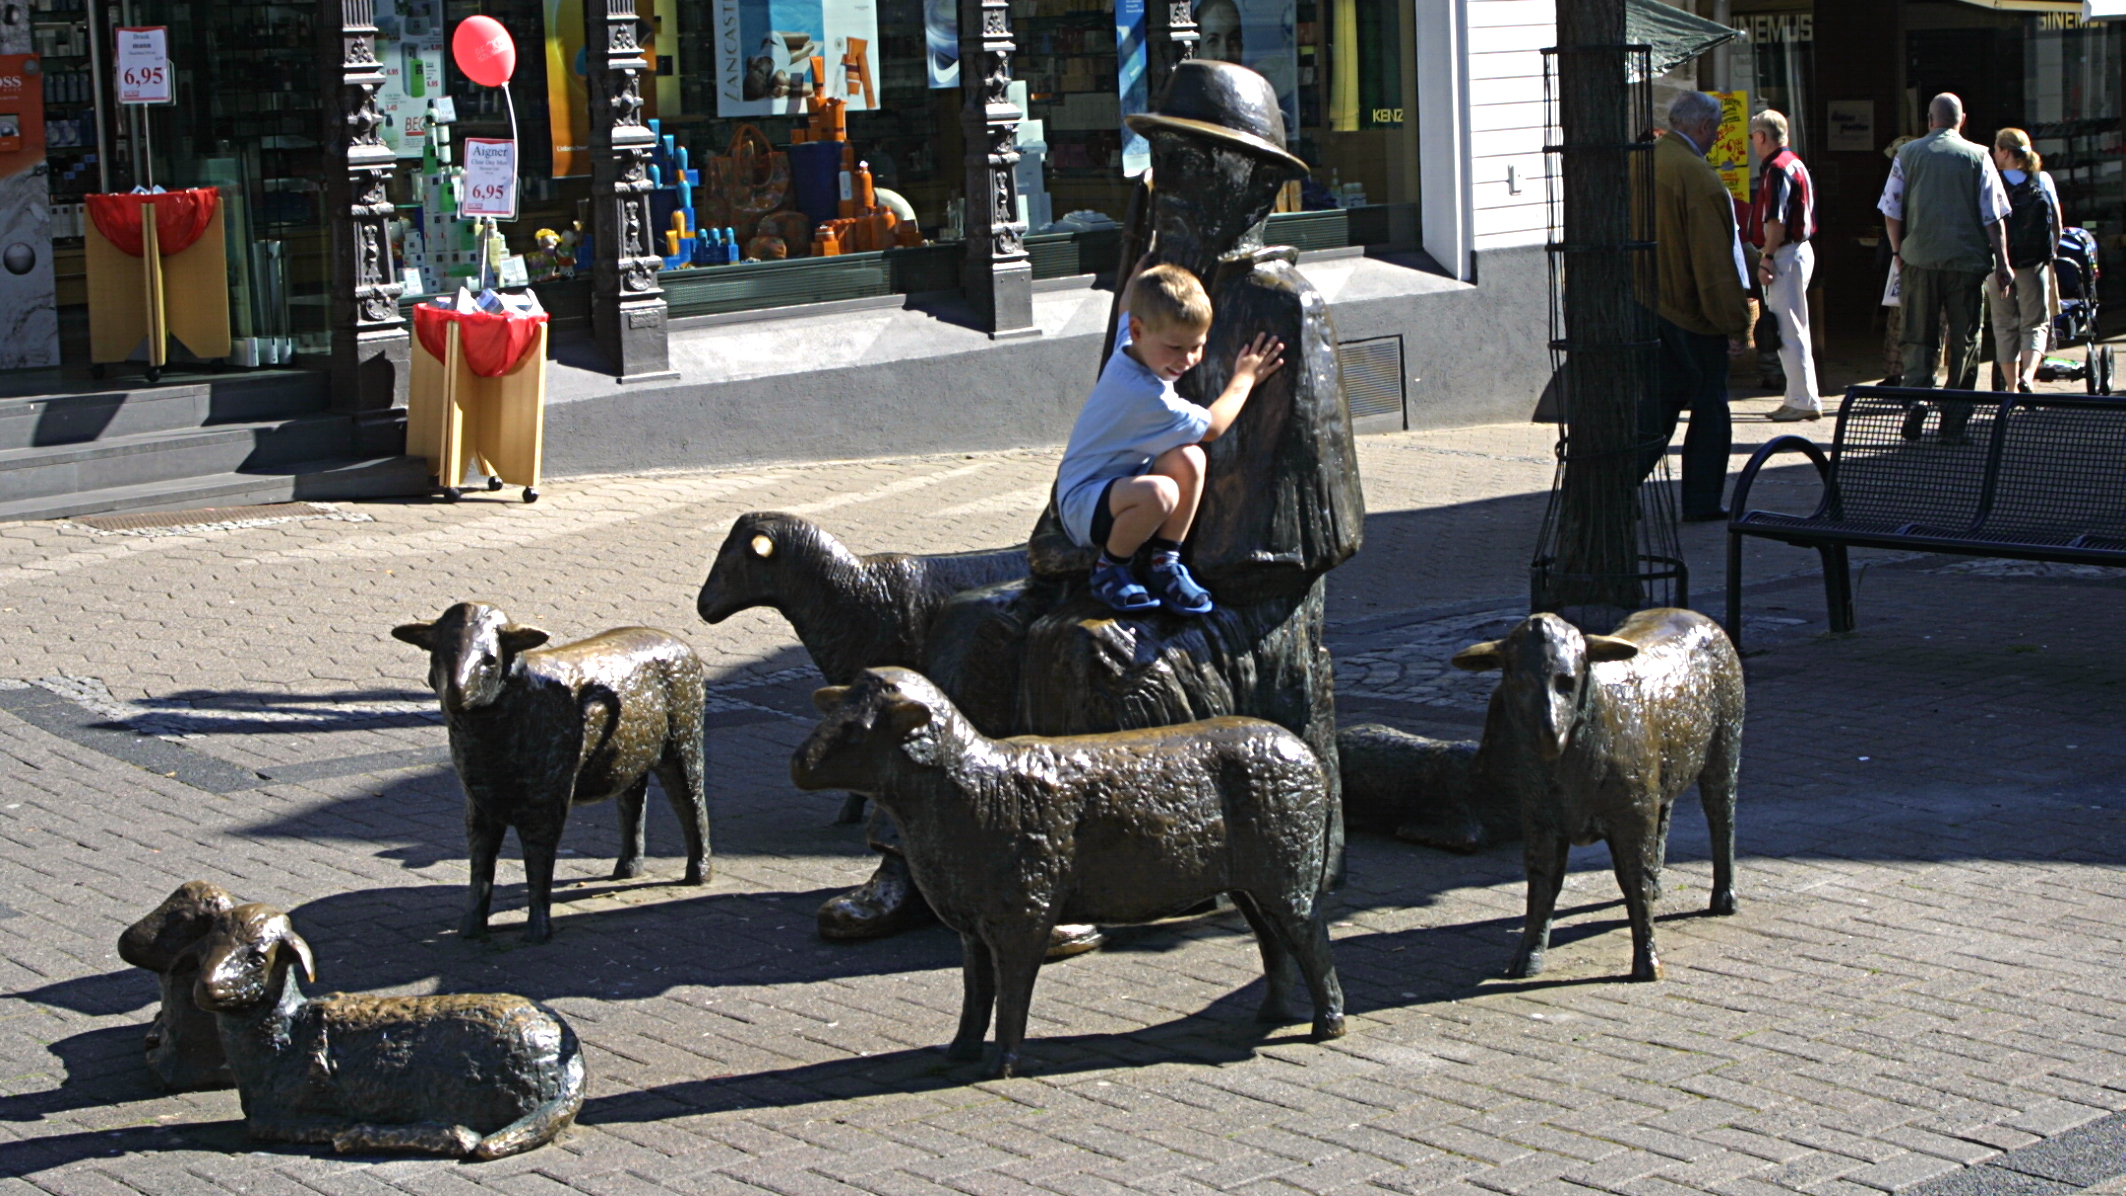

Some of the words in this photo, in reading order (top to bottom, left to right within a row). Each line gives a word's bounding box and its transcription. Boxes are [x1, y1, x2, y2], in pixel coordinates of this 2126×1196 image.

[124, 66, 163, 88] 6,95
[472, 145, 509, 159] Aigner
[472, 184, 504, 201] 6,95
